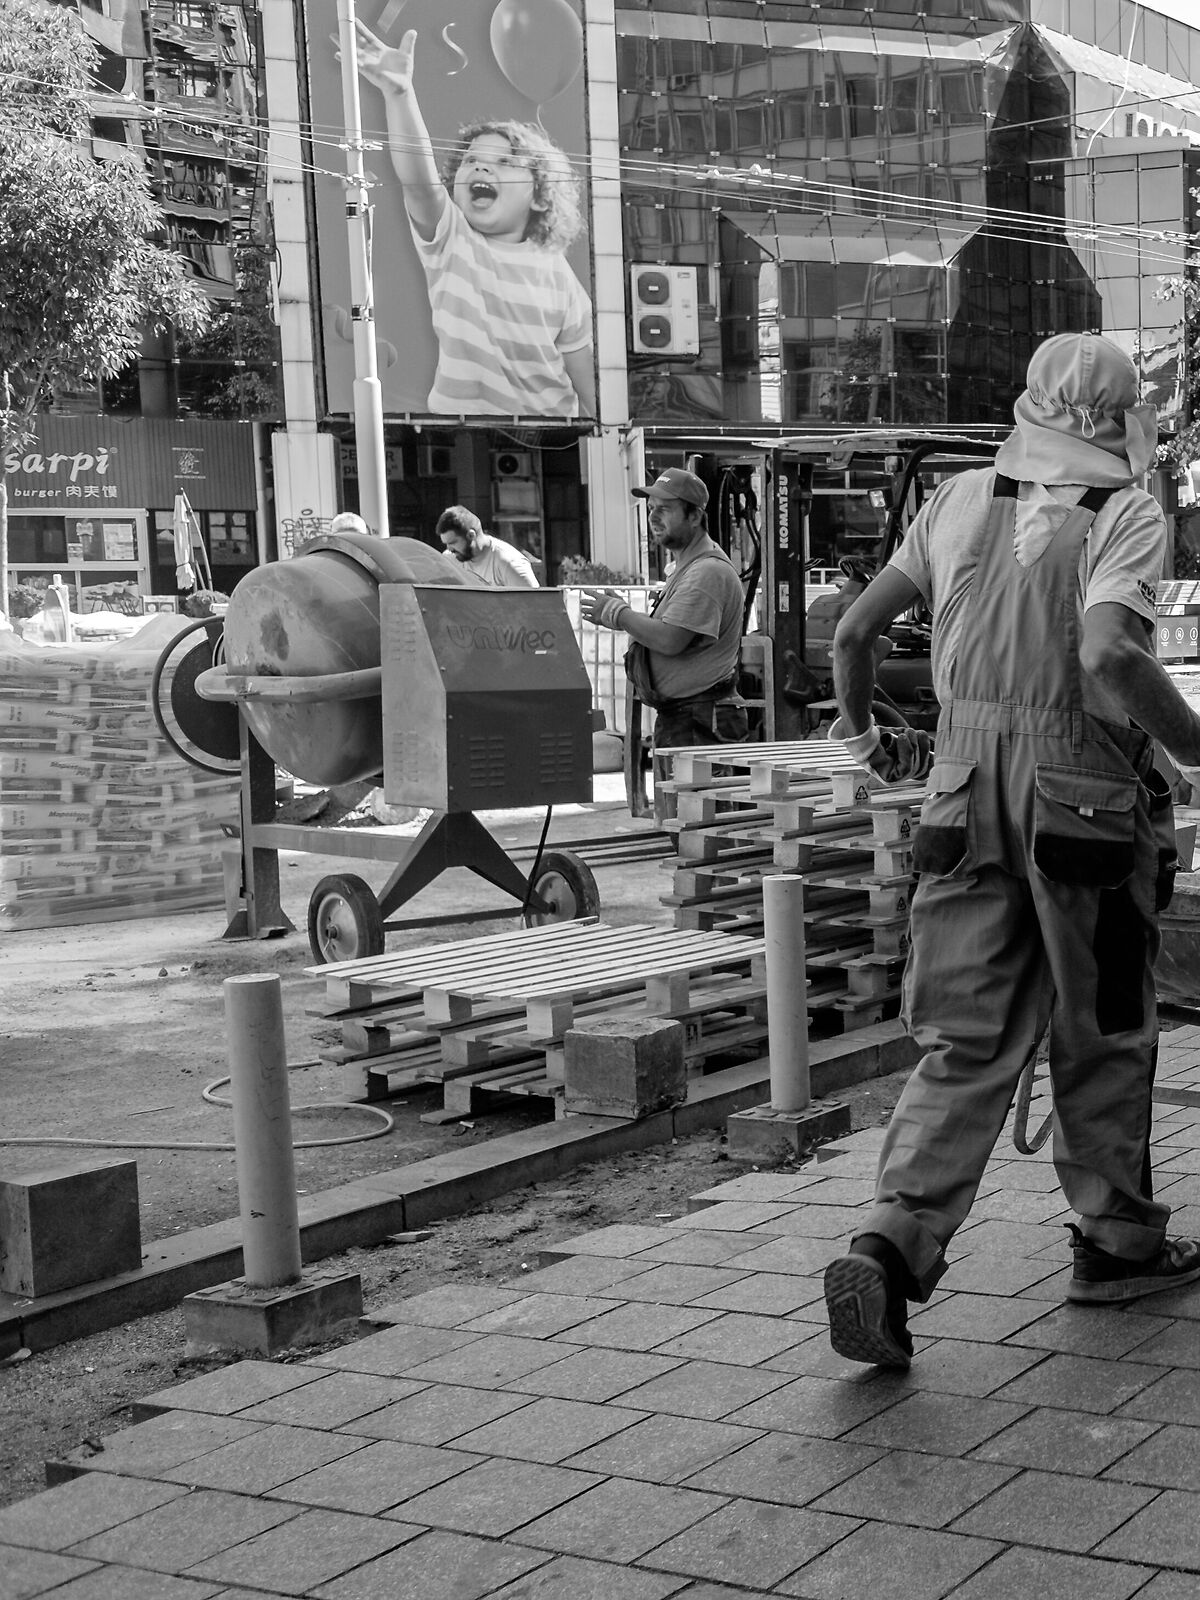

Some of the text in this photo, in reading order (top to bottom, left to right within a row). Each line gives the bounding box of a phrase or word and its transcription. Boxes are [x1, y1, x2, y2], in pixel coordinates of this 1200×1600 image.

[4, 446, 110, 482] sarpi
[14, 488, 62, 498] burger
[778, 474, 789, 549] KOMATSU
